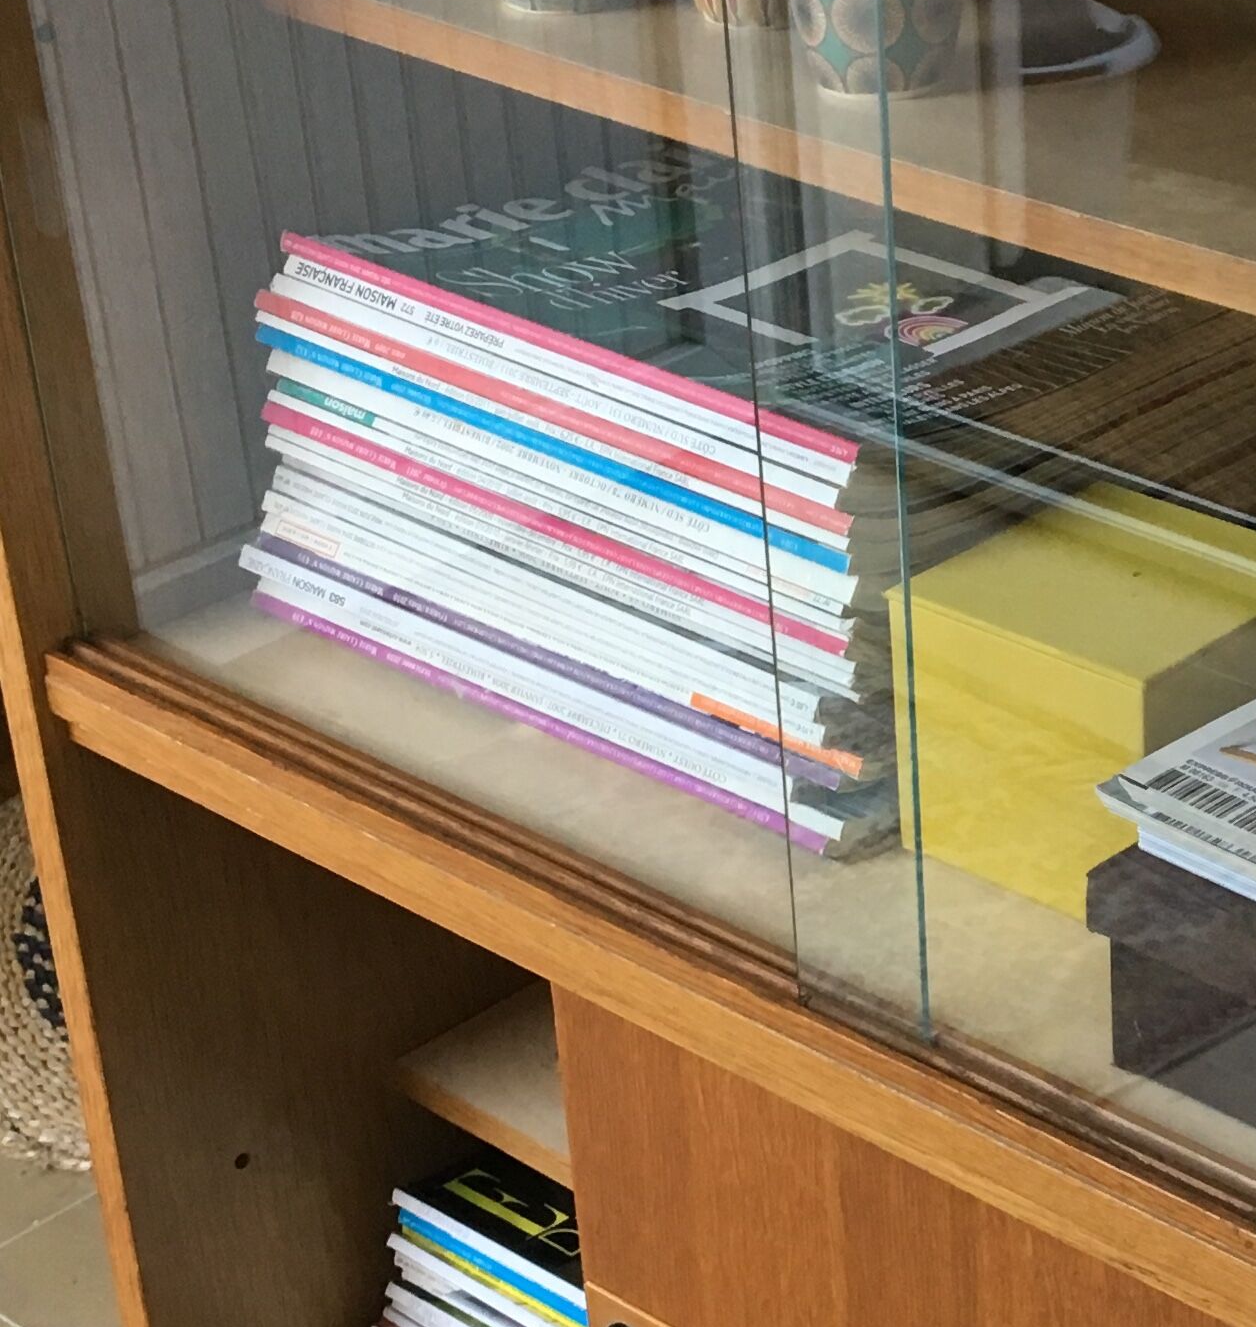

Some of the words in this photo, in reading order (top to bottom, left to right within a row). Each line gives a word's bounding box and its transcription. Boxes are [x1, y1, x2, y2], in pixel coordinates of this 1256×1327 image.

[295, 260, 354, 295] FRANÇAISE
[356, 283, 397, 311] MAISON
[400, 299, 415, 318] 572
[441, 315, 463, 336] VOTRE
[464, 323, 504, 351] PRÉPAREZ
[323, 395, 365, 423] maison
[292, 574, 326, 599] MAISON
[329, 590, 345, 608] 583
